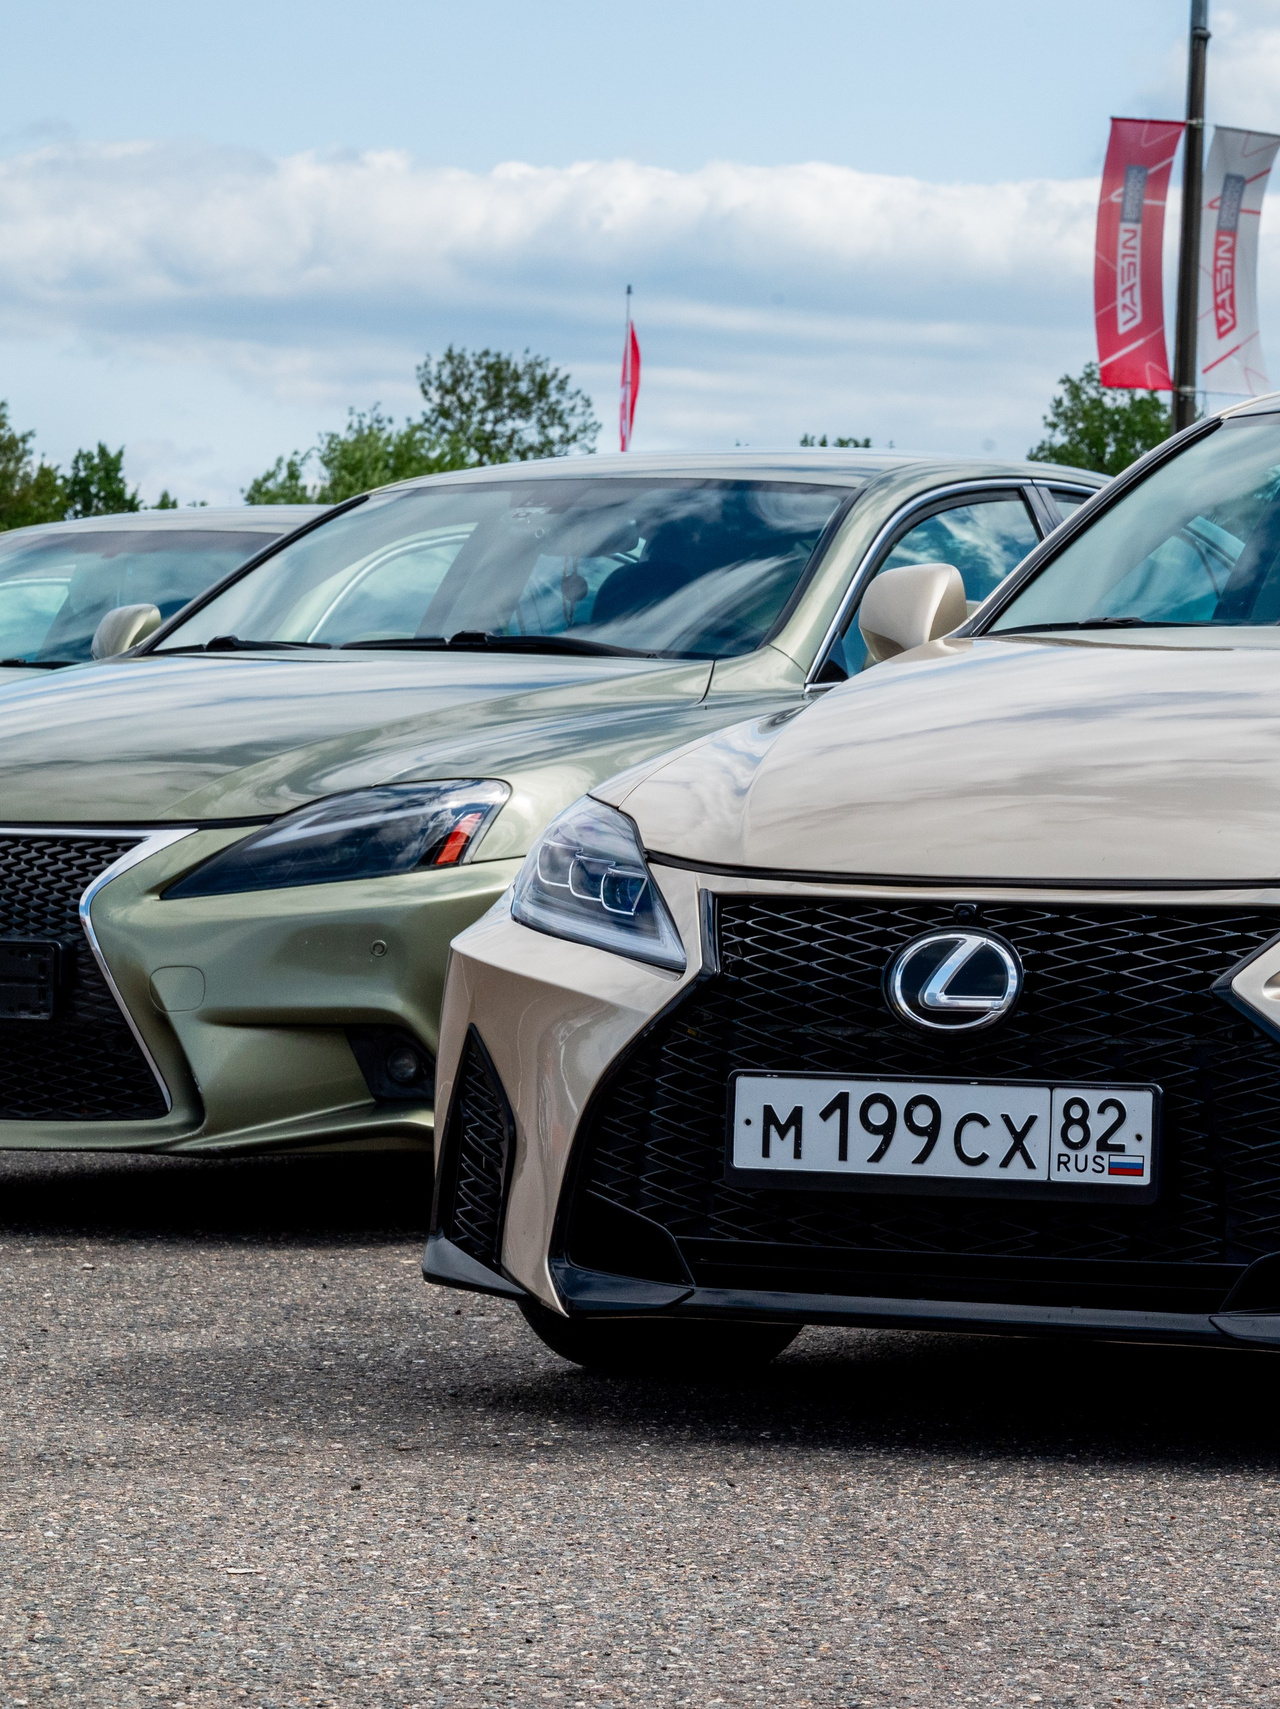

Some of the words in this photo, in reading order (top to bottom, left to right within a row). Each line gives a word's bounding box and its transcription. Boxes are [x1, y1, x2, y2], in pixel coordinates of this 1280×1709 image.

[1120, 228, 1138, 326] VASIN
[1216, 235, 1235, 333] VASIN
[1059, 1096, 1127, 1153] 82
[1056, 1152, 1106, 1175] RUS
